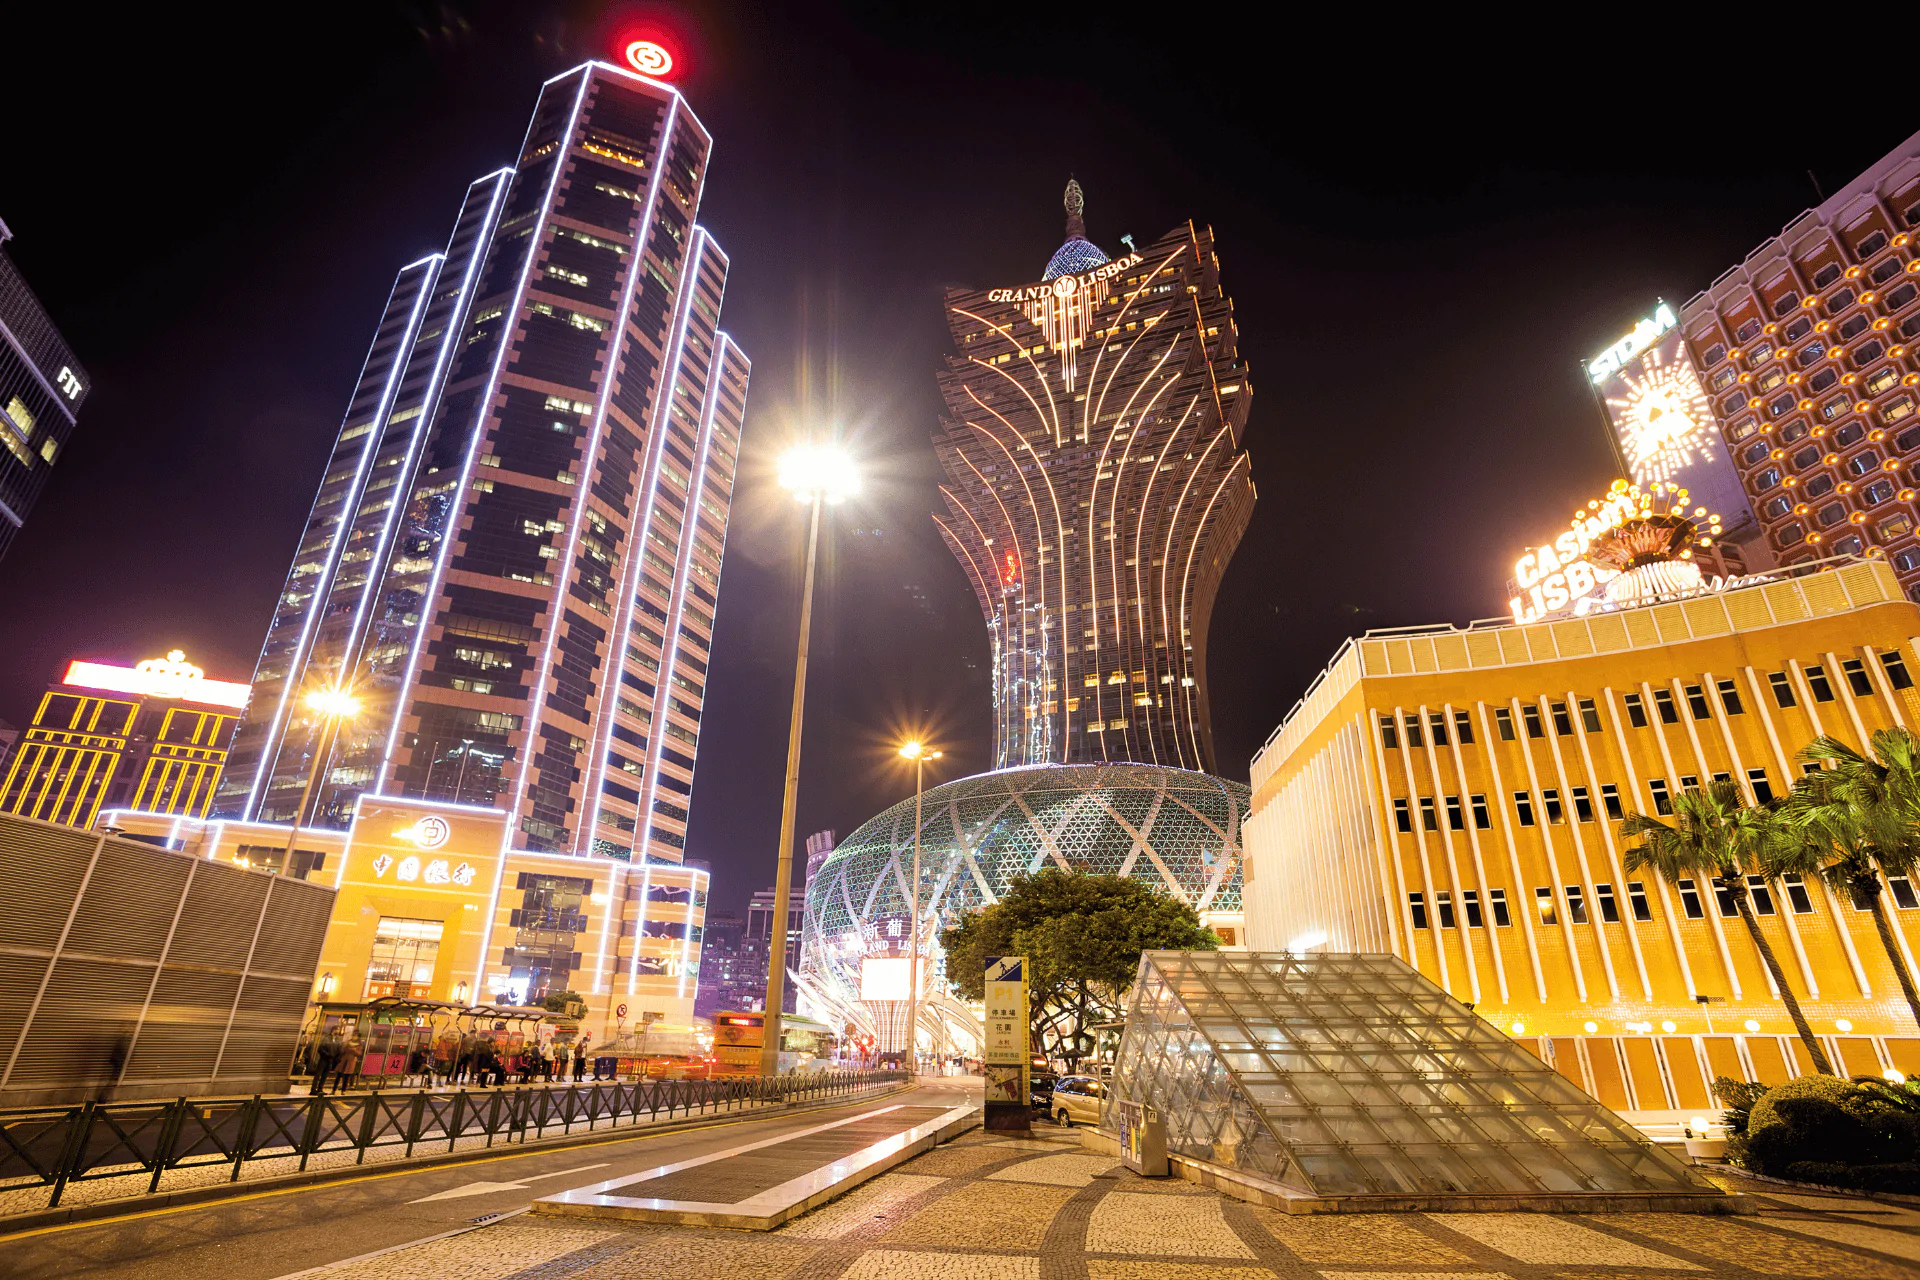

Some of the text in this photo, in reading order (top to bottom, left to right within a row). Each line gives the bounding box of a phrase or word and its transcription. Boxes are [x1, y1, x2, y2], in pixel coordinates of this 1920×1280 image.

[988, 252, 1144, 303] GRAND LISBOA
[57, 366, 82, 400] FIT
[995, 987, 1013, 1000] P1
